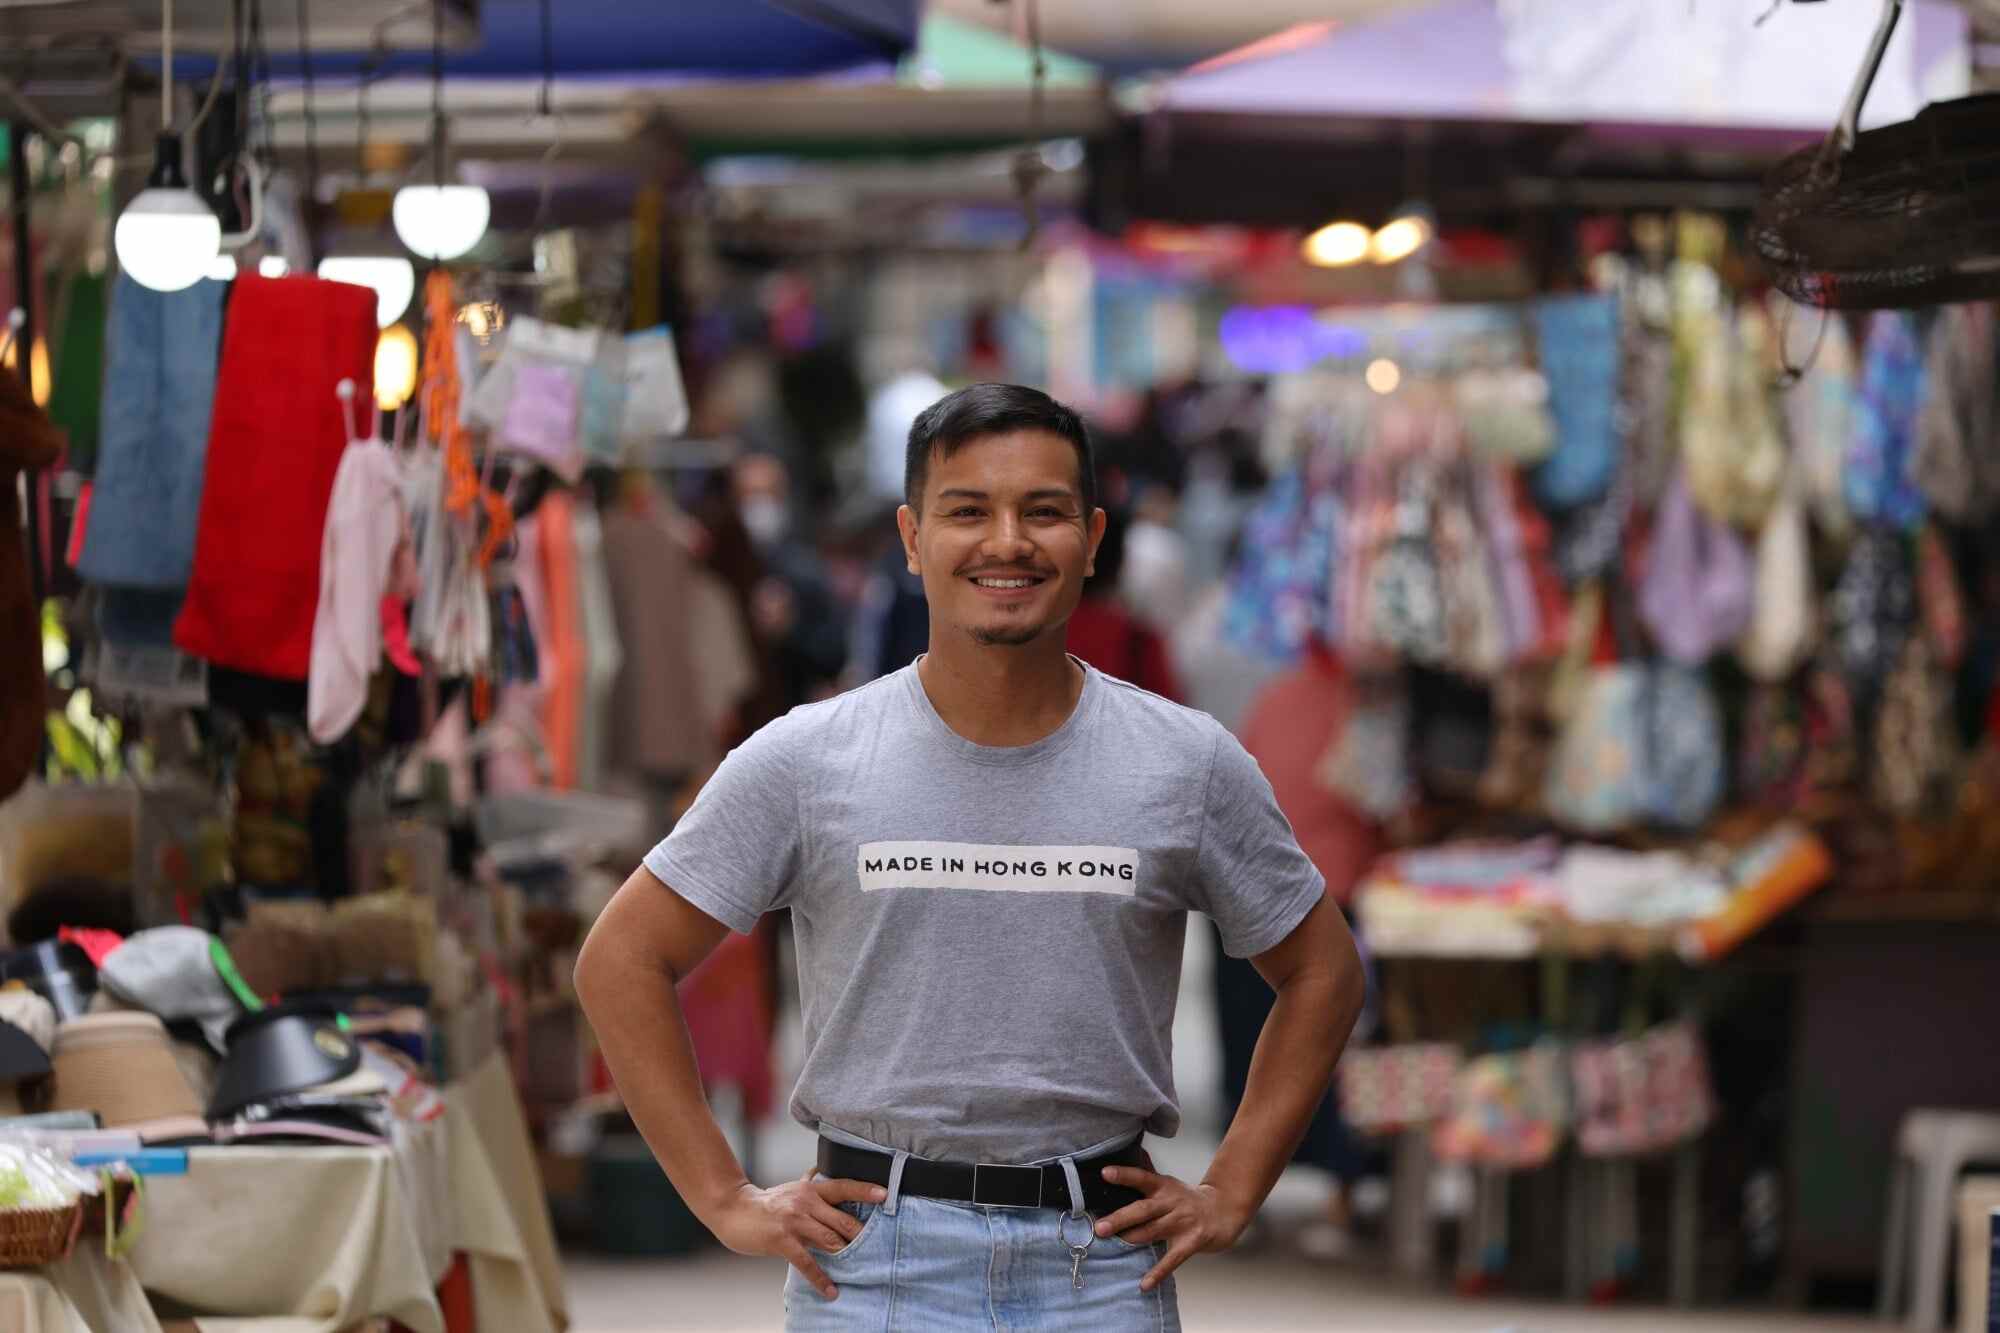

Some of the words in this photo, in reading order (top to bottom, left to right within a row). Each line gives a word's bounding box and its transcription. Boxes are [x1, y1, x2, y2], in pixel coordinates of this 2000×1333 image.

[865, 857, 933, 872] MADE
[942, 857, 964, 872] IN
[974, 861, 1047, 877] HONG
[1057, 861, 1133, 880] KONG
